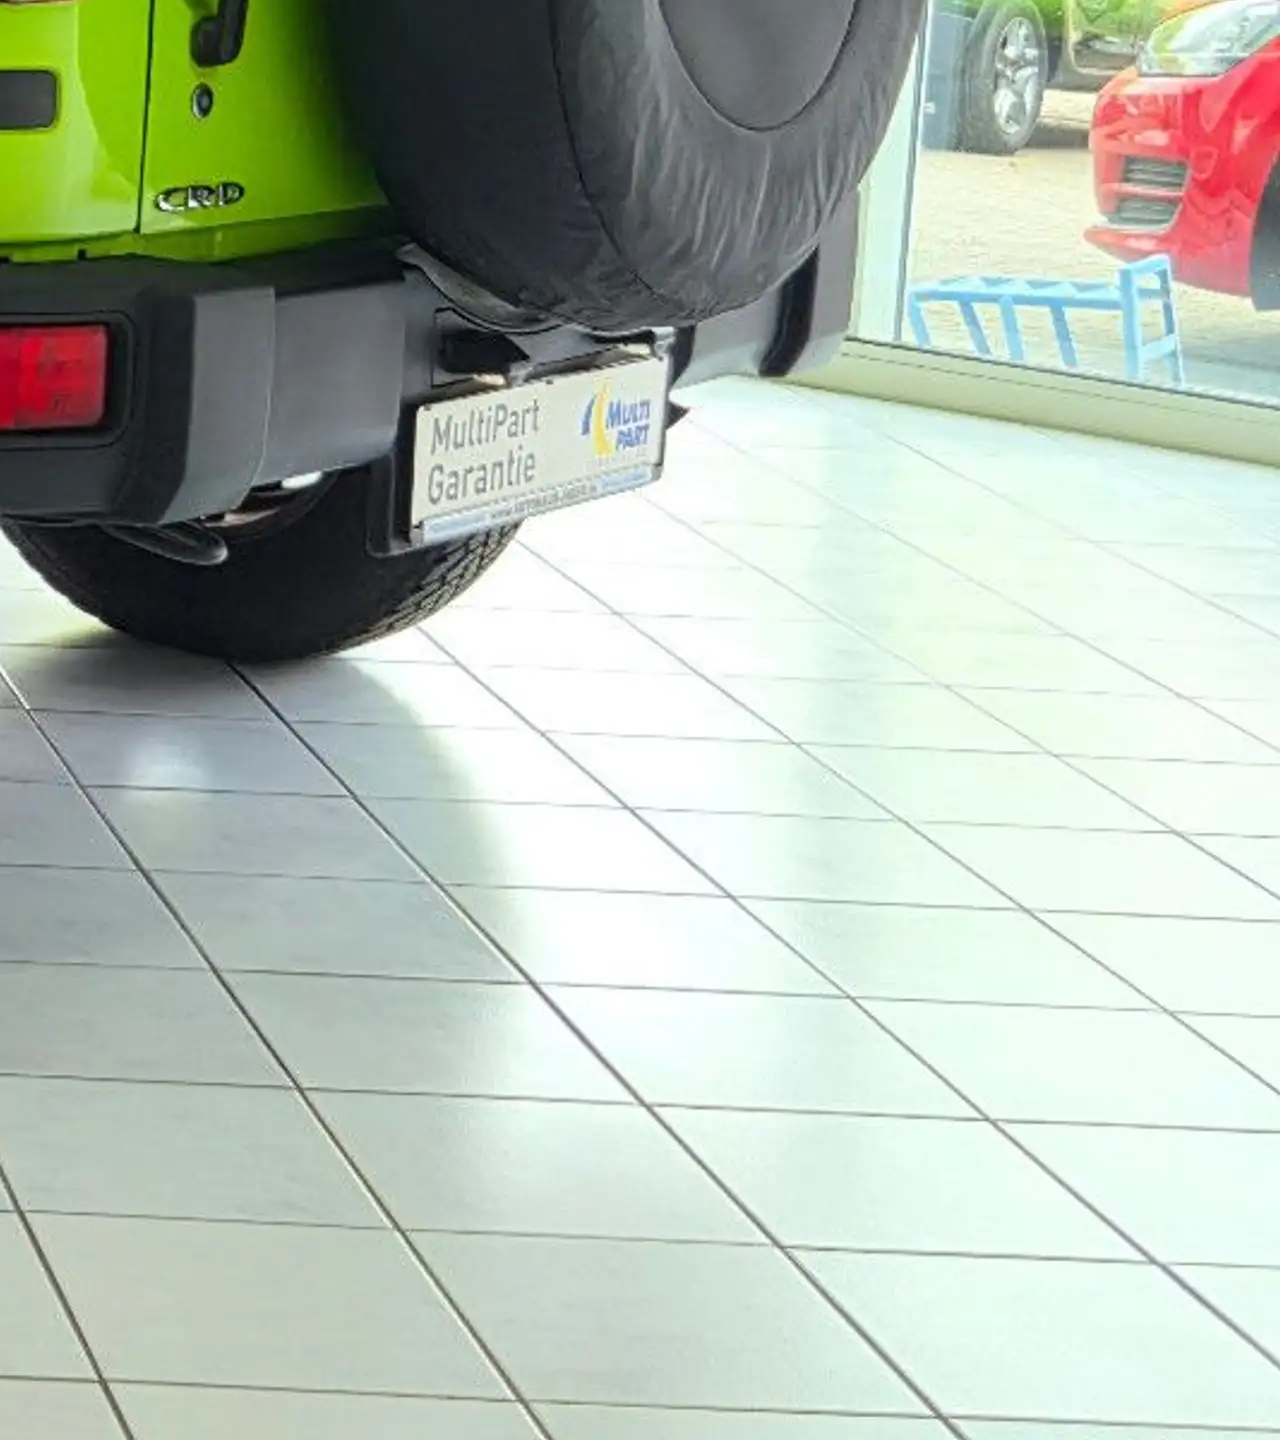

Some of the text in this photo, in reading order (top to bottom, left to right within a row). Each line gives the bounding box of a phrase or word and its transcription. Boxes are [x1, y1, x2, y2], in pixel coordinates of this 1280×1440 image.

[430, 399, 540, 456] MultiPart
[615, 425, 650, 450] PART
[427, 445, 536, 506] Garantie
